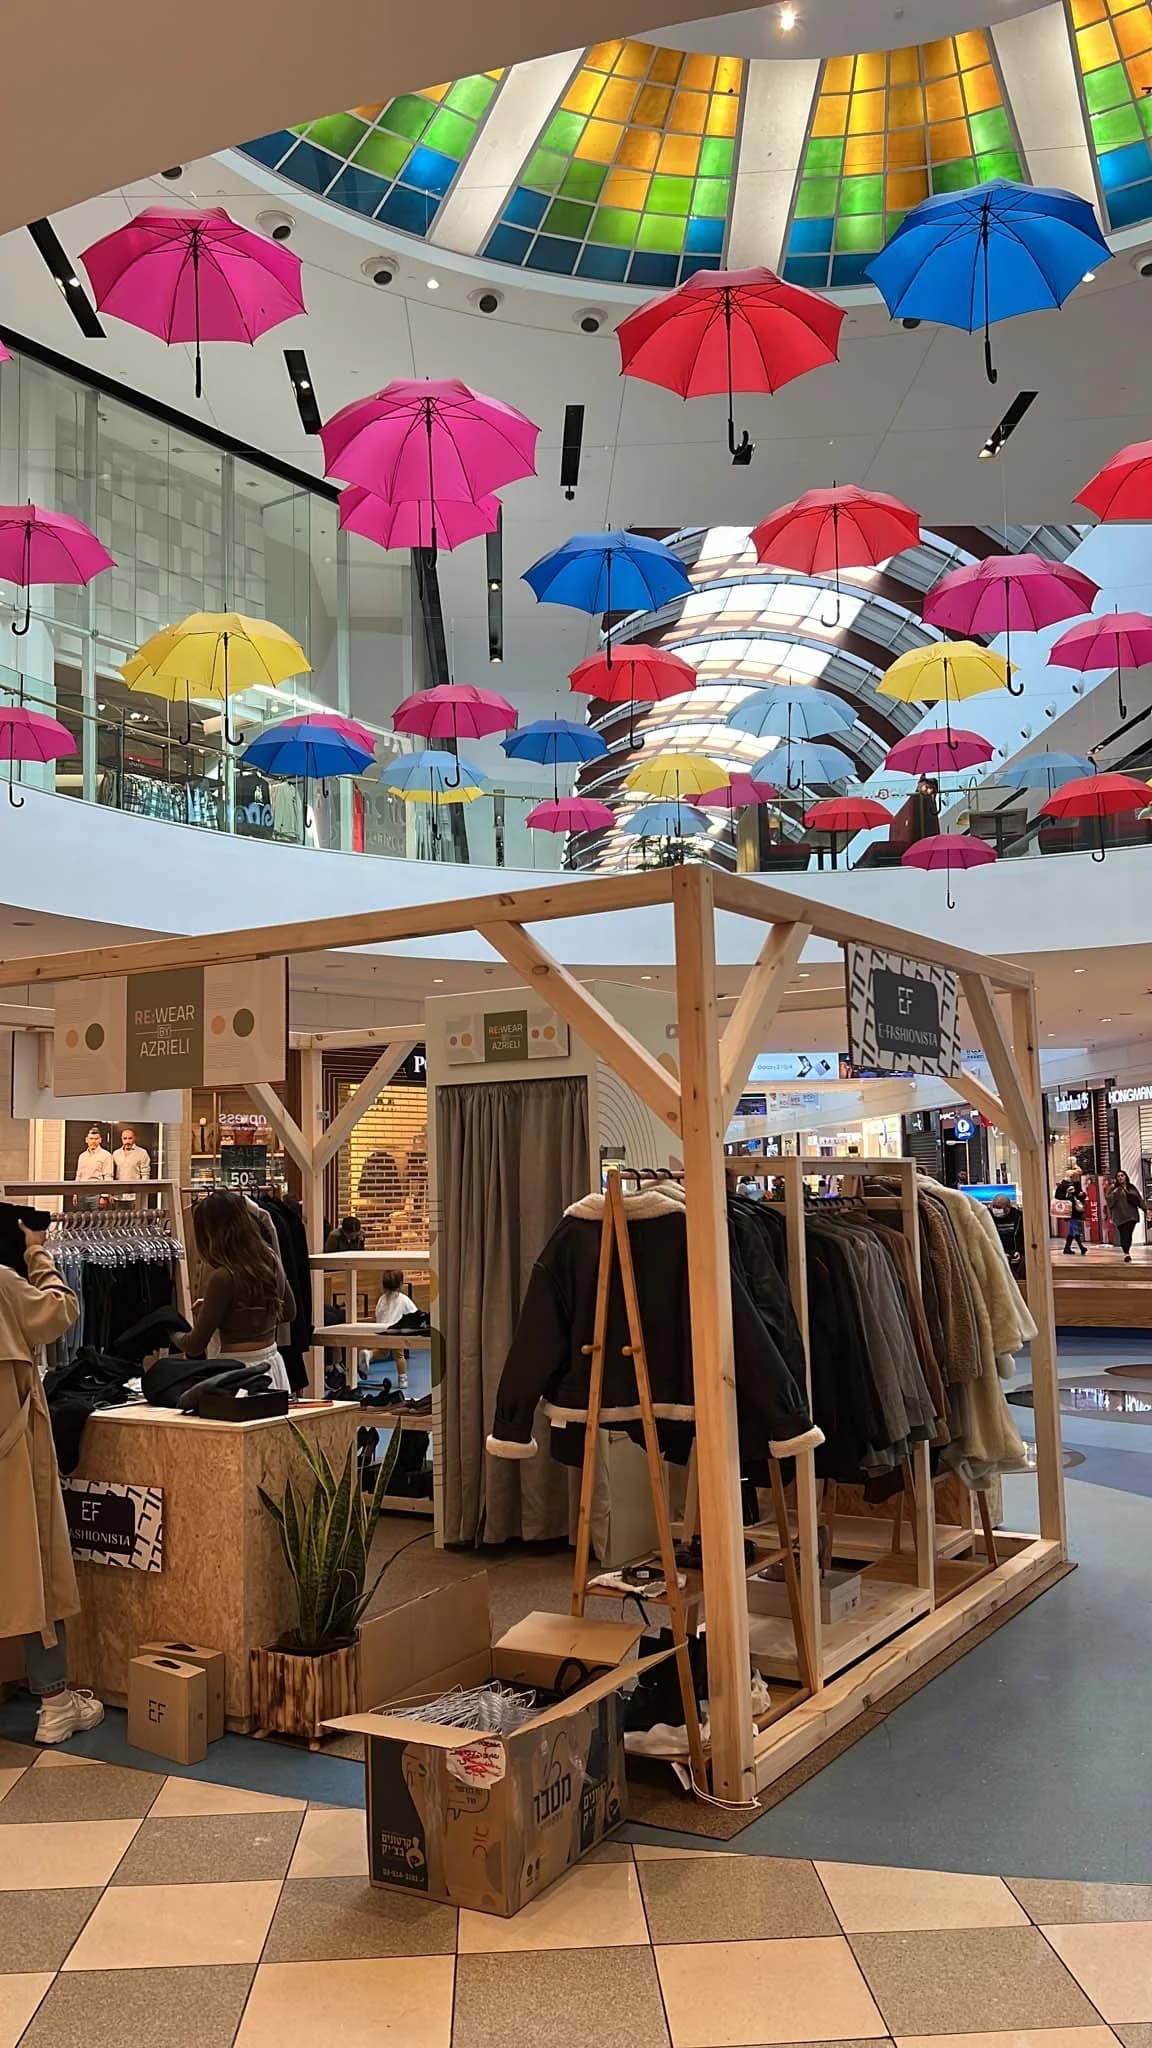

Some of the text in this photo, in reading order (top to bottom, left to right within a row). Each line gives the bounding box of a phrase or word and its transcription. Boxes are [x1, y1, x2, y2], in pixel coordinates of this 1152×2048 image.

[897, 986, 914, 1015] EF
[140, 1038, 190, 1057] AZRIELI
[492, 1040, 520, 1050] AZRIELI
[413, 1055, 427, 1073] P
[1090, 1201, 1098, 1222] SALE
[82, 1500, 102, 1521] EF
[149, 1699, 166, 1723] EF
[381, 1833, 411, 1849] קרטונים
